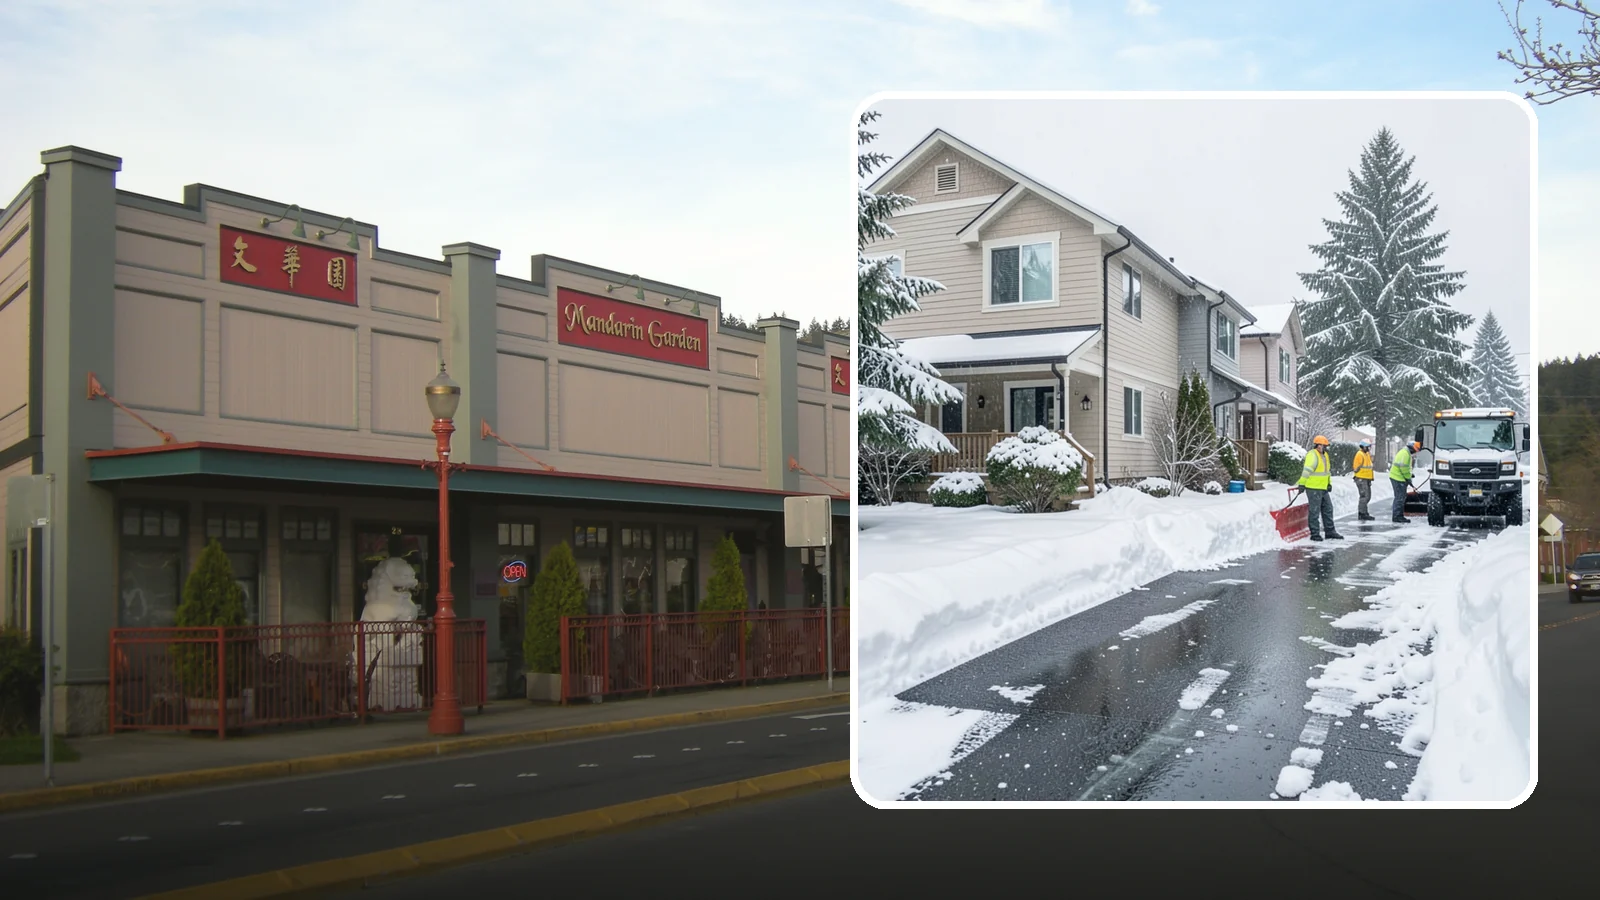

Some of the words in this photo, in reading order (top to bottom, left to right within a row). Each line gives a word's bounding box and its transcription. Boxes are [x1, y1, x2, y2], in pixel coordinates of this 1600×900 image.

[230, 235, 347, 291] 文華園
[564, 302, 644, 341] Mandarin
[647, 320, 702, 352] Garden
[503, 565, 527, 578] OPEN
